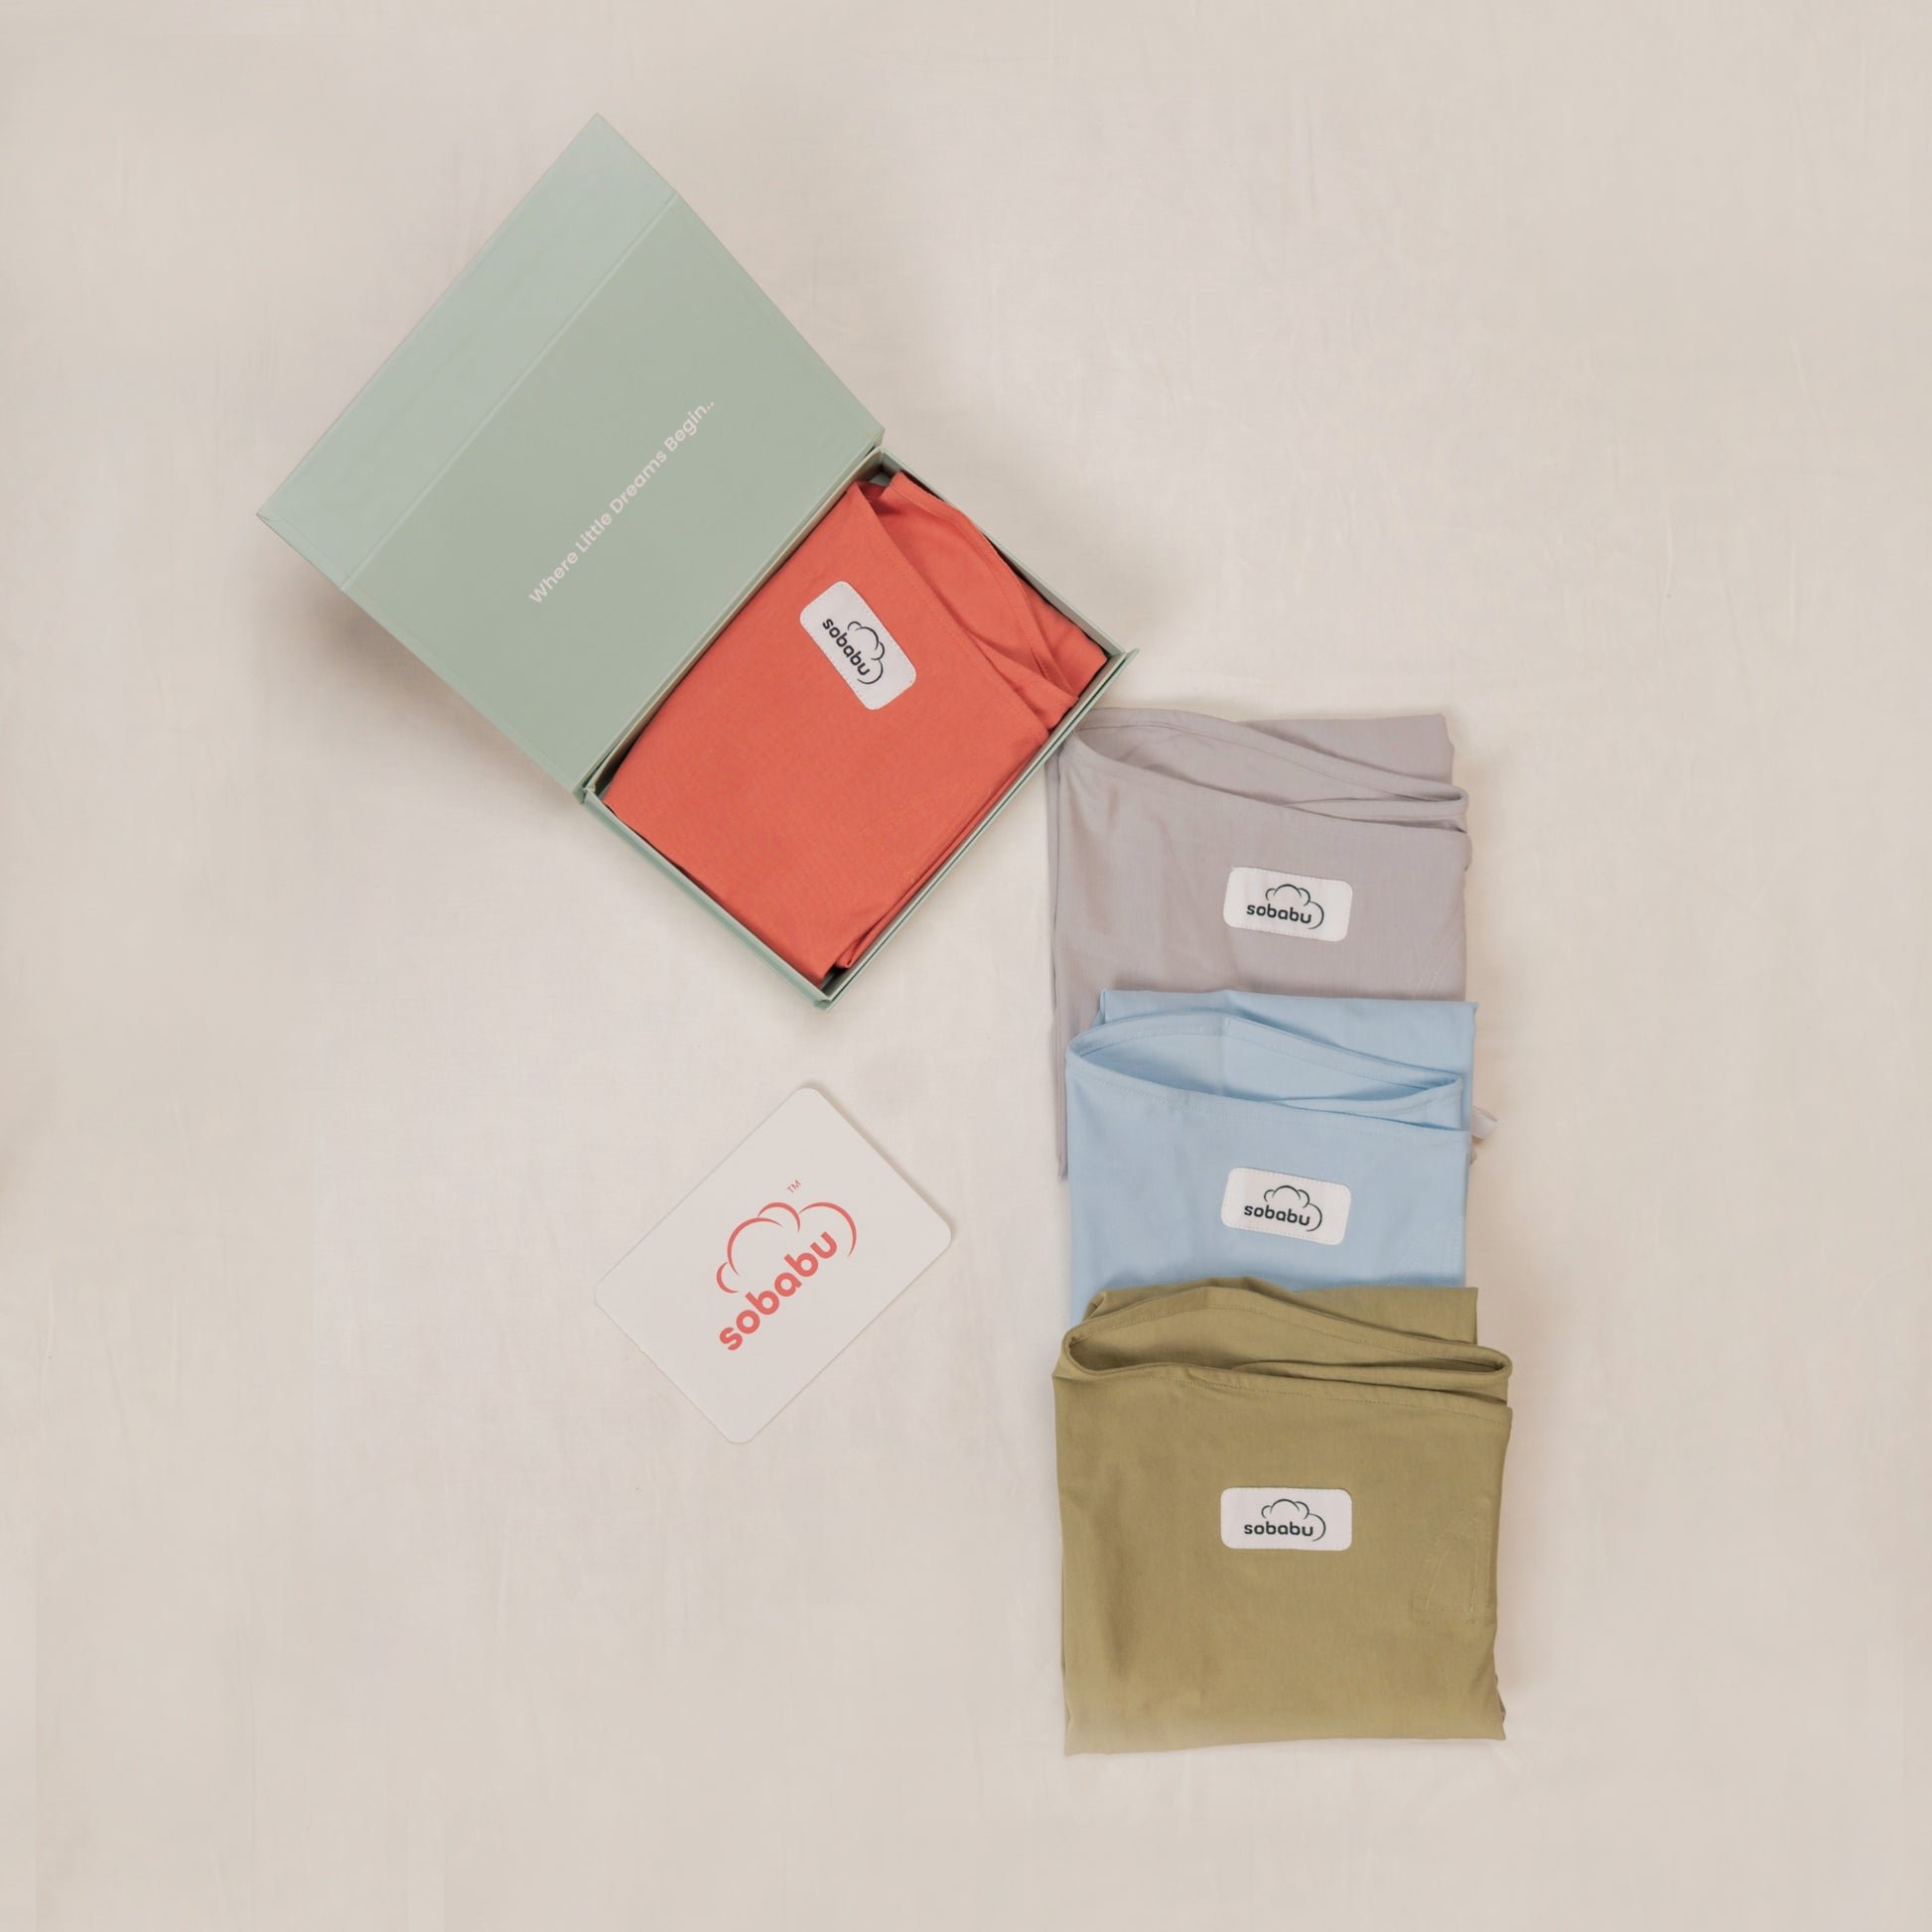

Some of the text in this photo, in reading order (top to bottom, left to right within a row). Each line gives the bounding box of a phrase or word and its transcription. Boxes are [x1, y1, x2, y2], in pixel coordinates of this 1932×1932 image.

[528, 401, 715, 603] Where Little Dreams Begin..
[822, 619, 870, 676] sobabu
[1246, 903, 1312, 924] sobabu
[1244, 1204, 1311, 1226] sobabu
[719, 1231, 838, 1351] sobabu
[1243, 1521, 1313, 1537] sobabu
